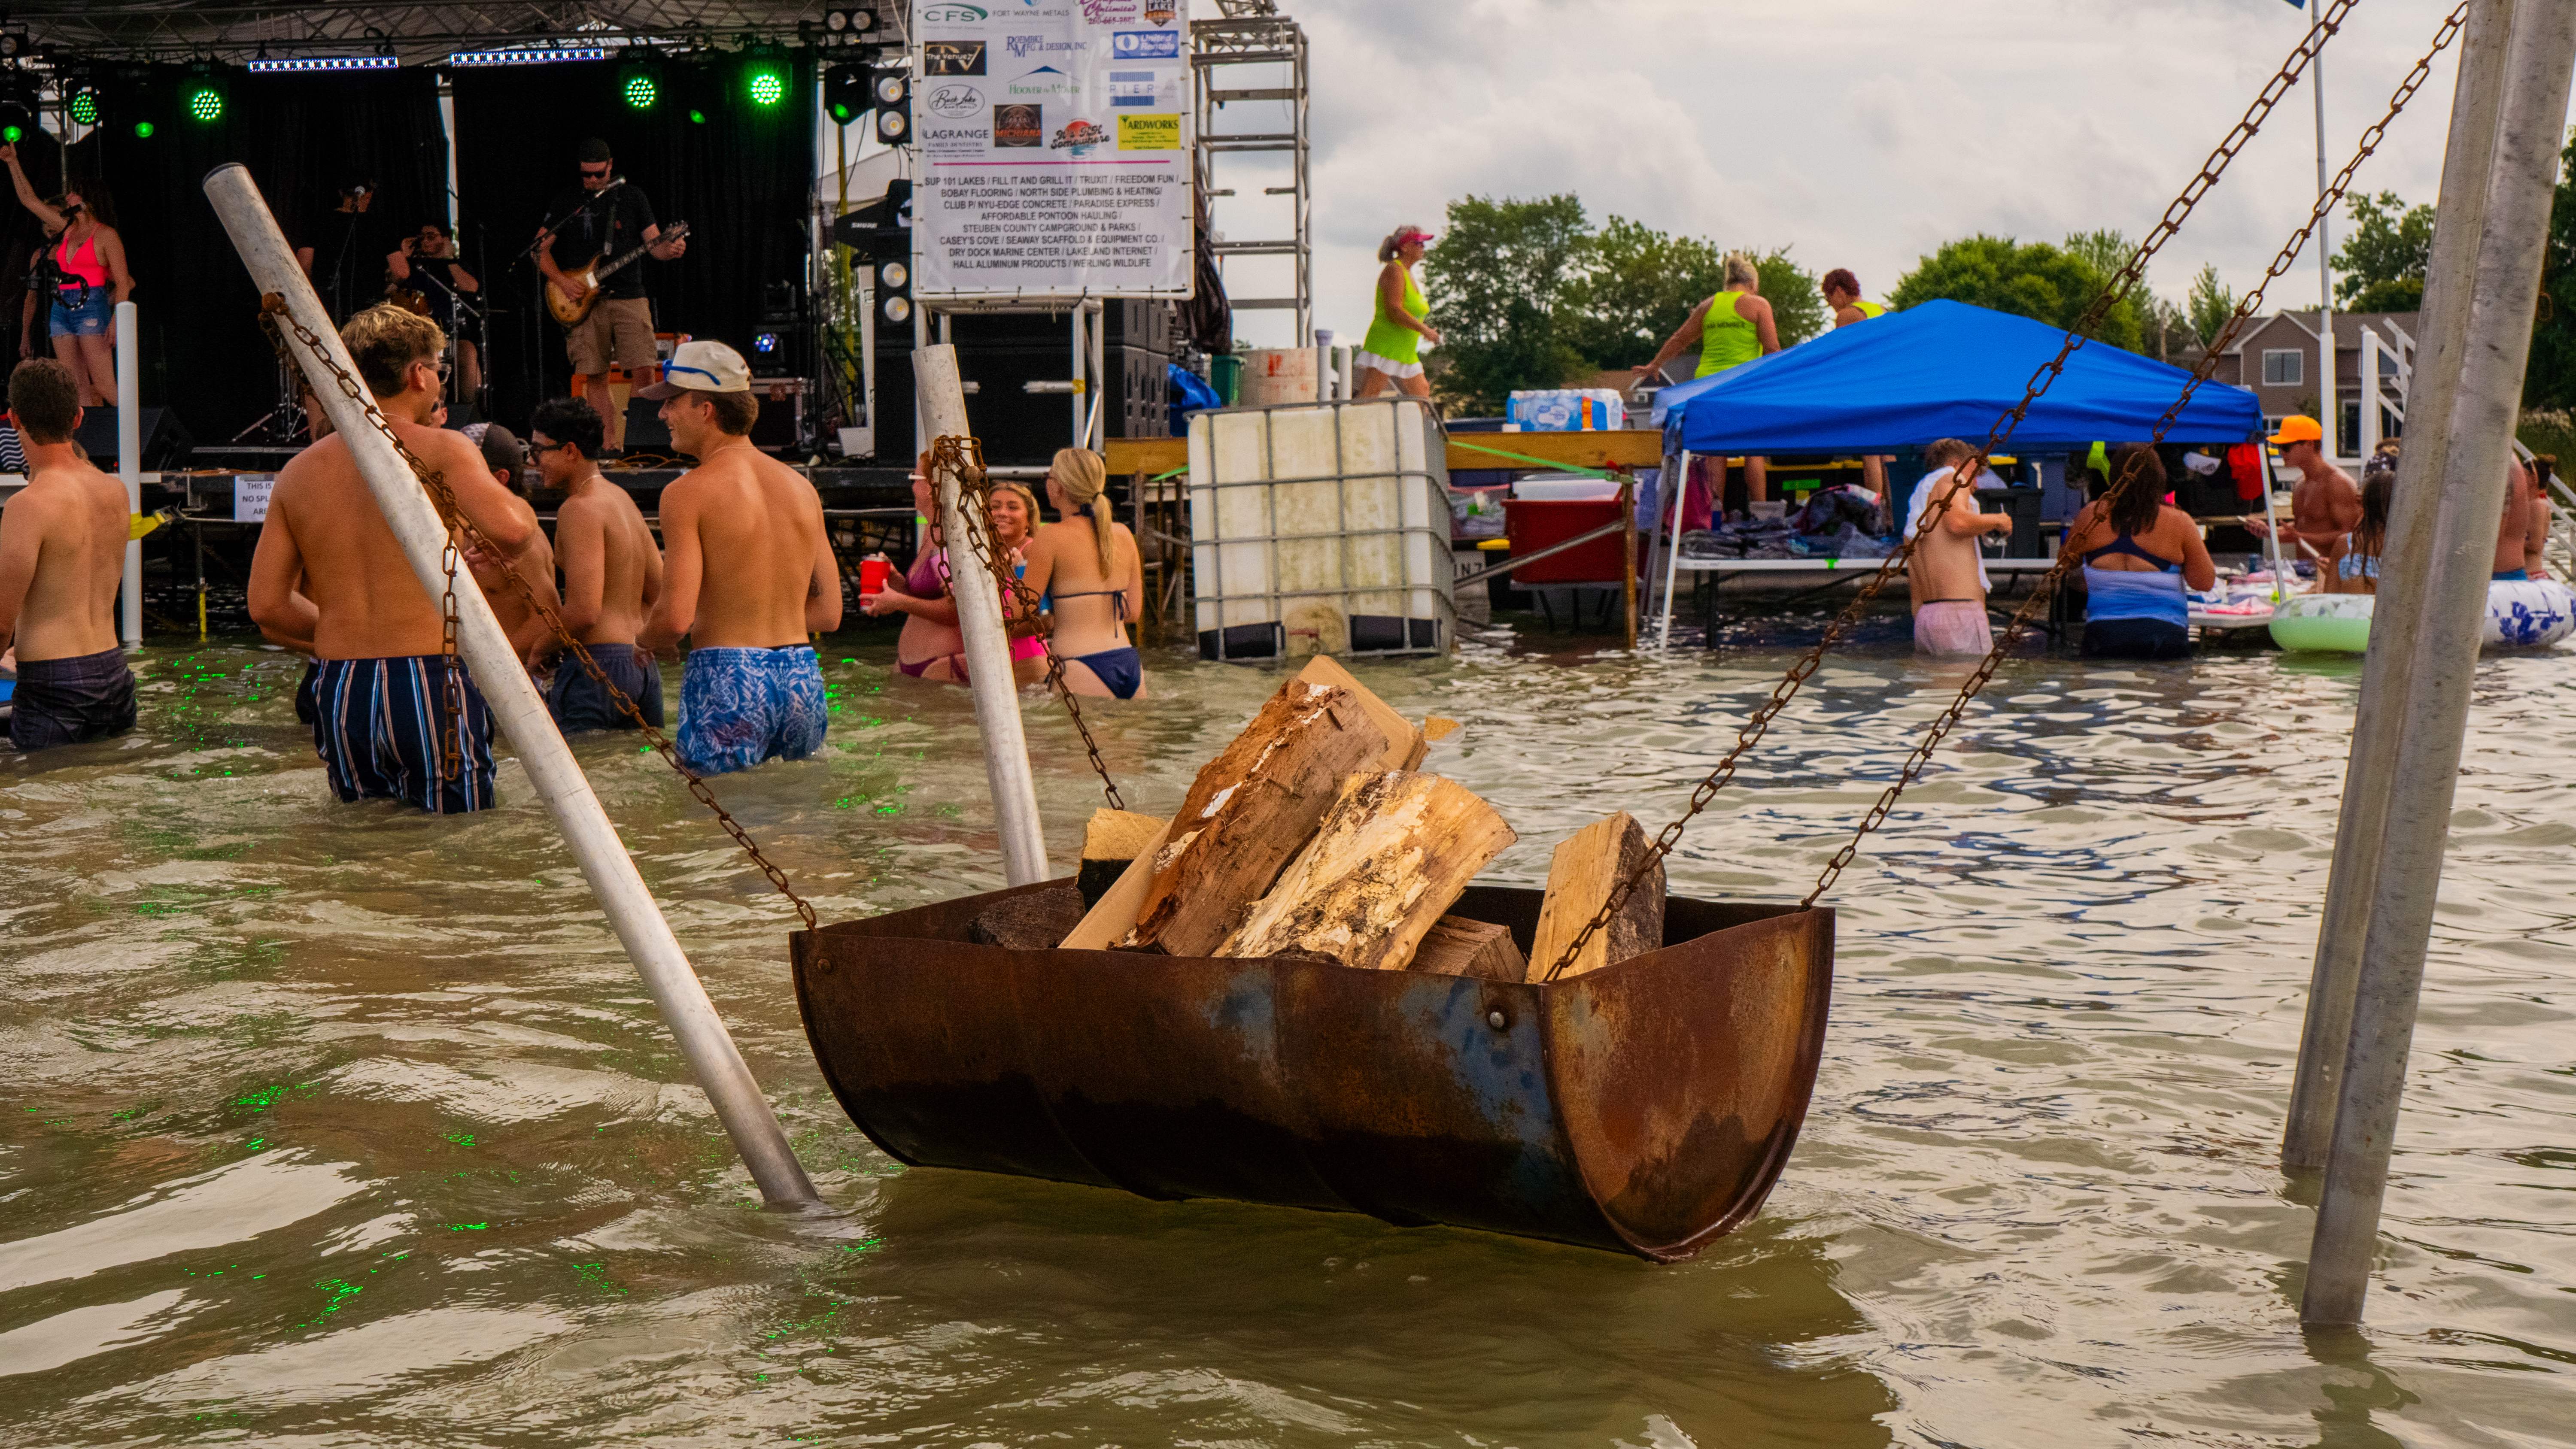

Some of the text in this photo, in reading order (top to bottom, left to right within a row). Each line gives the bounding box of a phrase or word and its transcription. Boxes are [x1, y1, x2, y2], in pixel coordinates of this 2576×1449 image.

[924, 11, 975, 21] CFS
[1009, 84, 1042, 94] HOOVER
[925, 130, 989, 139] LAGRANGE
[1050, 135, 1111, 149] Somewhere
[925, 177, 941, 185] SUP
[944, 177, 956, 185] 101
[958, 176, 985, 185] LAKES
[992, 176, 1009, 185] FILL
[1011, 176, 1018, 185] IT
[1020, 176, 1037, 185] AND
[1040, 176, 1063, 185] GRILL
[1066, 176, 1072, 184] IT
[1080, 175, 1108, 184] TRUXIT
[1115, 175, 1155, 184] FREEDOM
[1157, 174, 1174, 183] FUN
[941, 188, 969, 197] BOBAY
[971, 188, 1013, 197] FLOORING
[1020, 188, 1048, 197] NORTH
[1051, 188, 1069, 196] SIDE
[1072, 187, 1114, 196] PLUMBING
[1117, 187, 1122, 195] &
[945, 200, 966, 209] CLUB
[978, 200, 1020, 209] NYU-EDGE
[1023, 199, 1067, 209] CONCRETE
[1074, 199, 1115, 208] PARADISE
[1117, 198, 1155, 207] EXPRESS
[981, 212, 1036, 221] AFFORDABLE
[1038, 211, 1078, 220] PONTOON
[1081, 211, 1117, 220] HAULING
[963, 224, 1001, 233] STEUBEN
[1003, 224, 1037, 232] COUNTY
[1039, 223, 1098, 232] CAMPGROUND
[1101, 223, 1106, 231] &
[1109, 223, 1136, 232] PARKS
[940, 236, 975, 245] CASEY'S
[977, 236, 999, 245] COVE
[1006, 235, 1039, 244] SEAWAY
[1042, 235, 1085, 244] SCAFFOLD
[1096, 234, 1143, 243] EQUIPMENT
[949, 248, 966, 257] DRY
[968, 248, 991, 257] DOCK
[993, 248, 1025, 257] MARINE
[1027, 247, 1060, 256] CENTER
[1113, 246, 1152, 255] INTERNET
[953, 260, 974, 269] HALL
[976, 260, 1020, 268] ALUMINUM
[1021, 259, 1066, 268] PRODUCTS
[1073, 258, 1111, 267] WERLING
[1113, 258, 1151, 267] WILDLIFE
